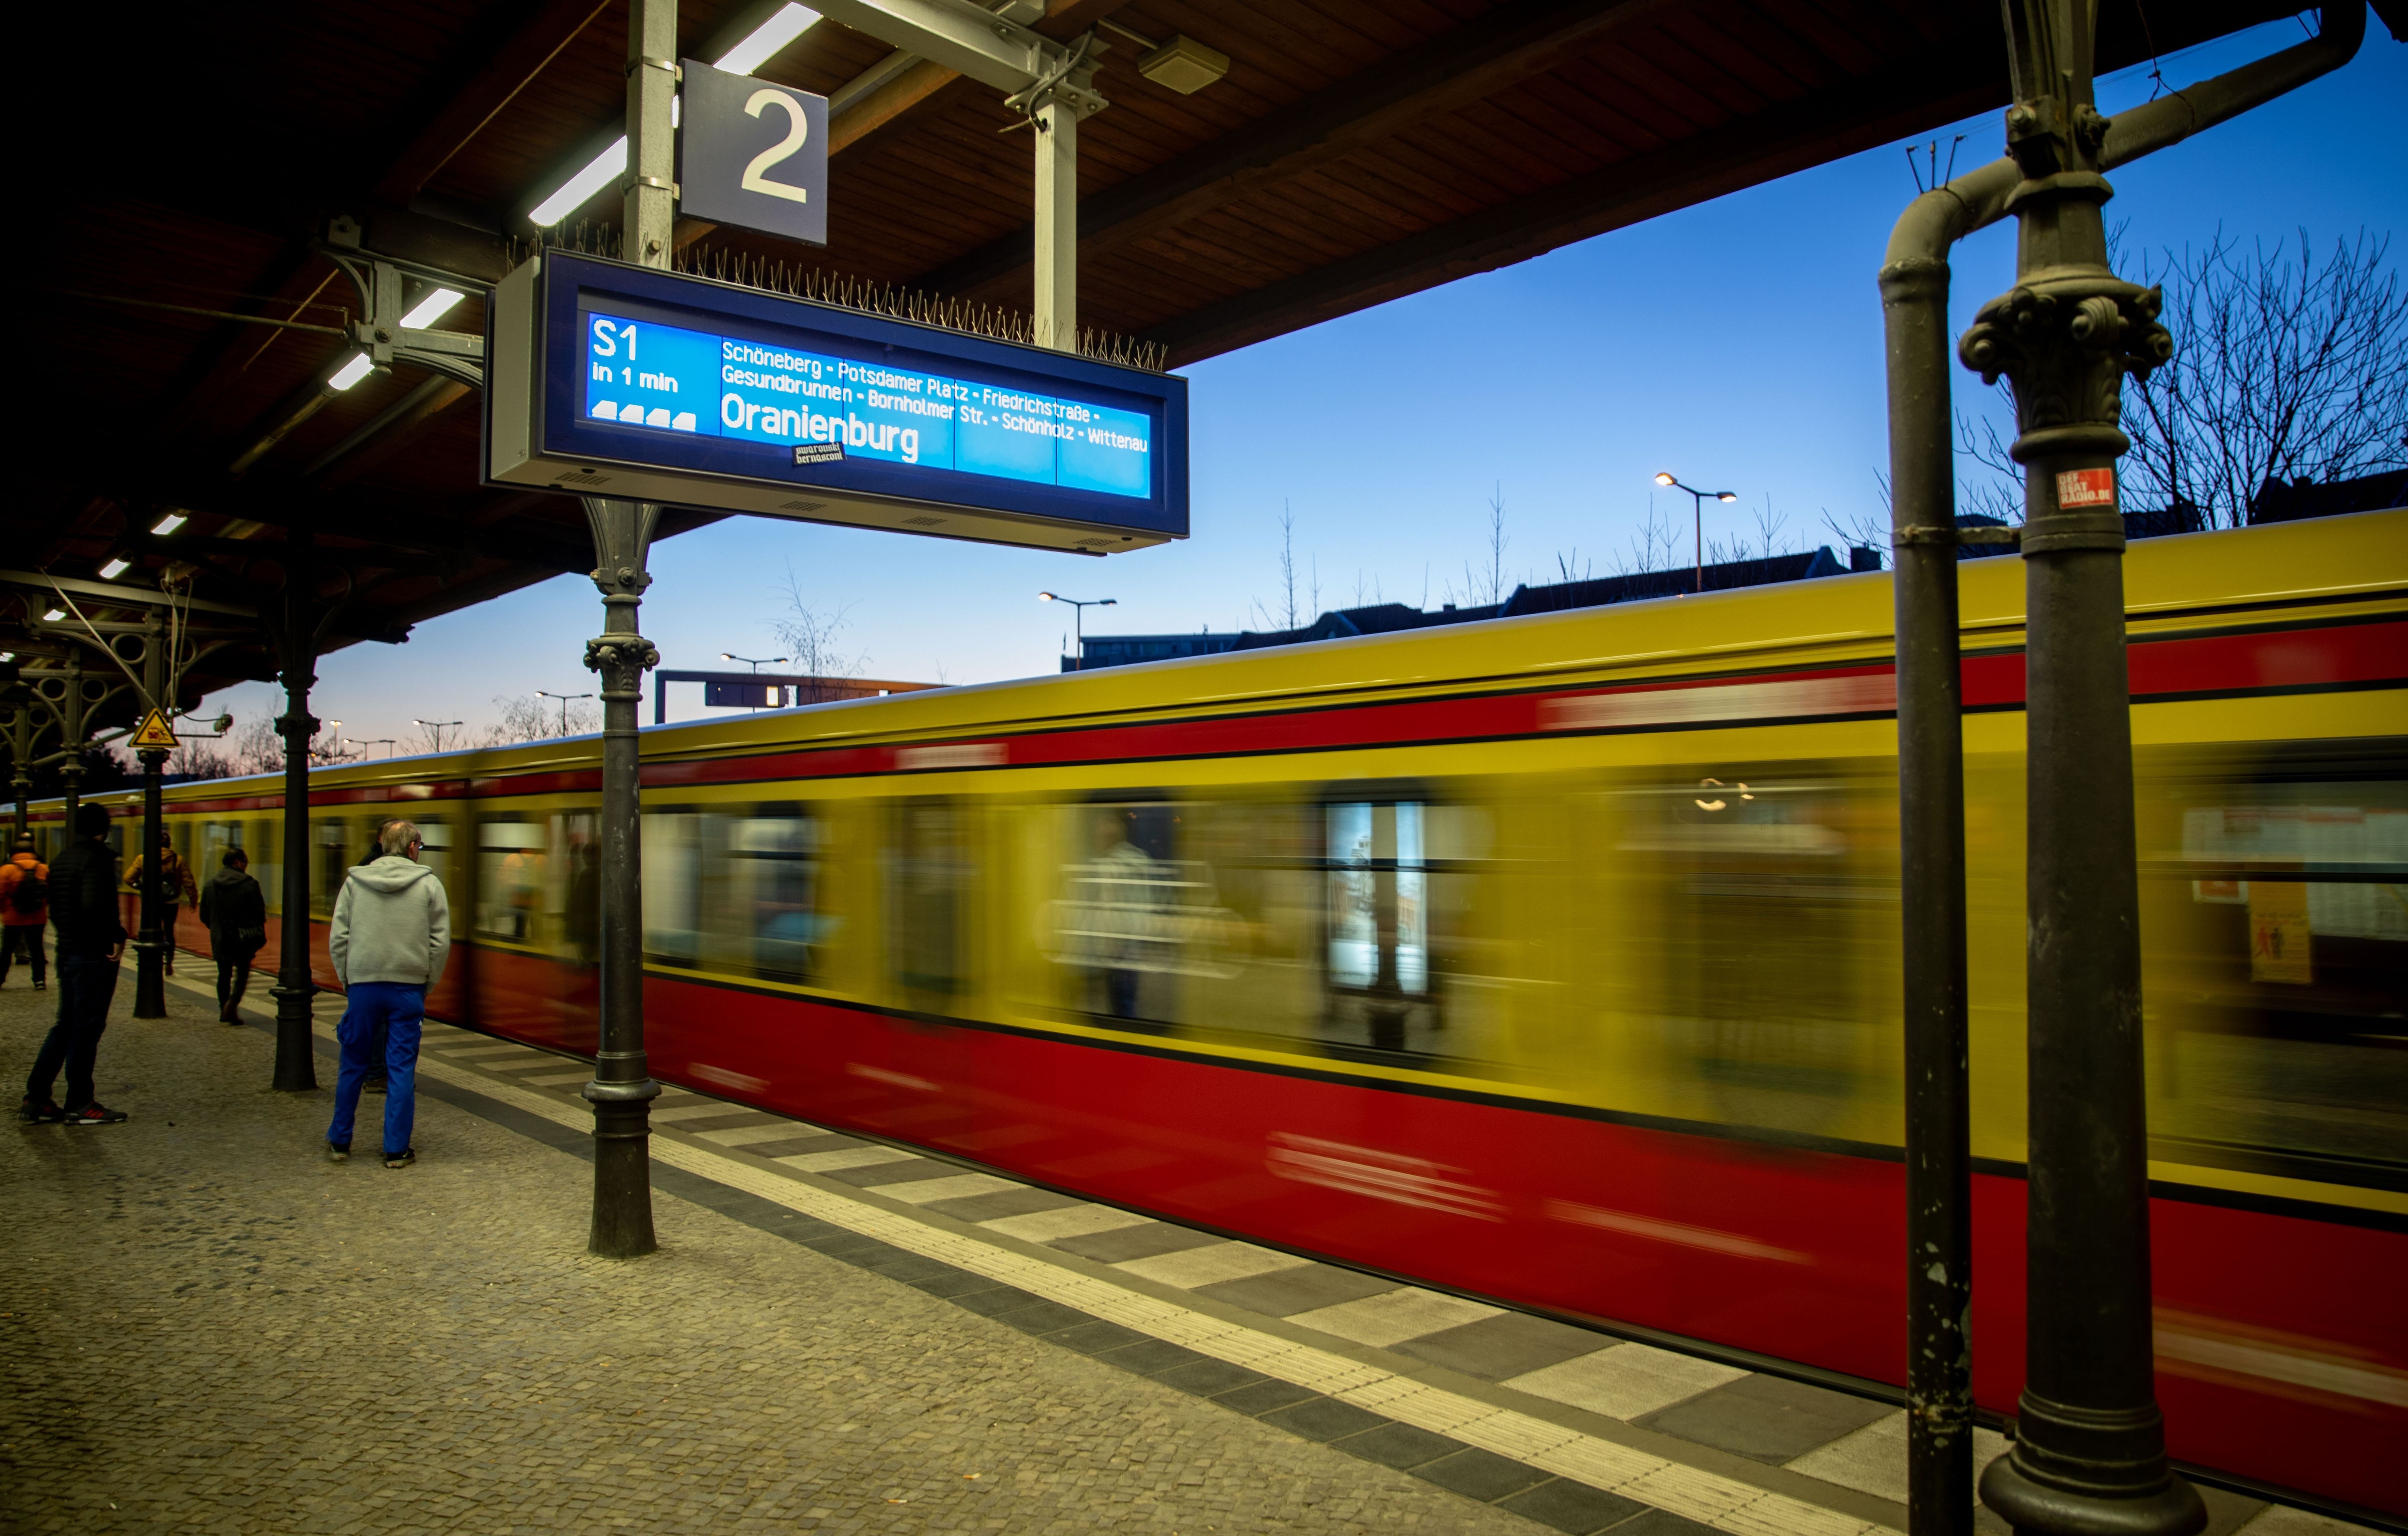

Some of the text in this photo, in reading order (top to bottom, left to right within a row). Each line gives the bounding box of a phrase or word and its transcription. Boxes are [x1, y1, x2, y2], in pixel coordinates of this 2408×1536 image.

[741, 88, 807, 204] 2
[594, 319, 636, 360] S1
[593, 362, 678, 393] in 1 min
[722, 342, 821, 380] Schöneberg
[838, 362, 923, 393] Potsdamer
[927, 378, 968, 401] Platz
[983, 389, 1090, 423] Friedrichstraße
[722, 365, 852, 403] Gesundbrunnen
[868, 389, 955, 419] Bornholmer
[960, 405, 988, 425] Str.
[1002, 412, 1074, 440] Schönholz
[1088, 427, 1147, 452] Wittenau
[721, 393, 919, 464] Oranienburg
[2059, 482, 2087, 493] BEAT
